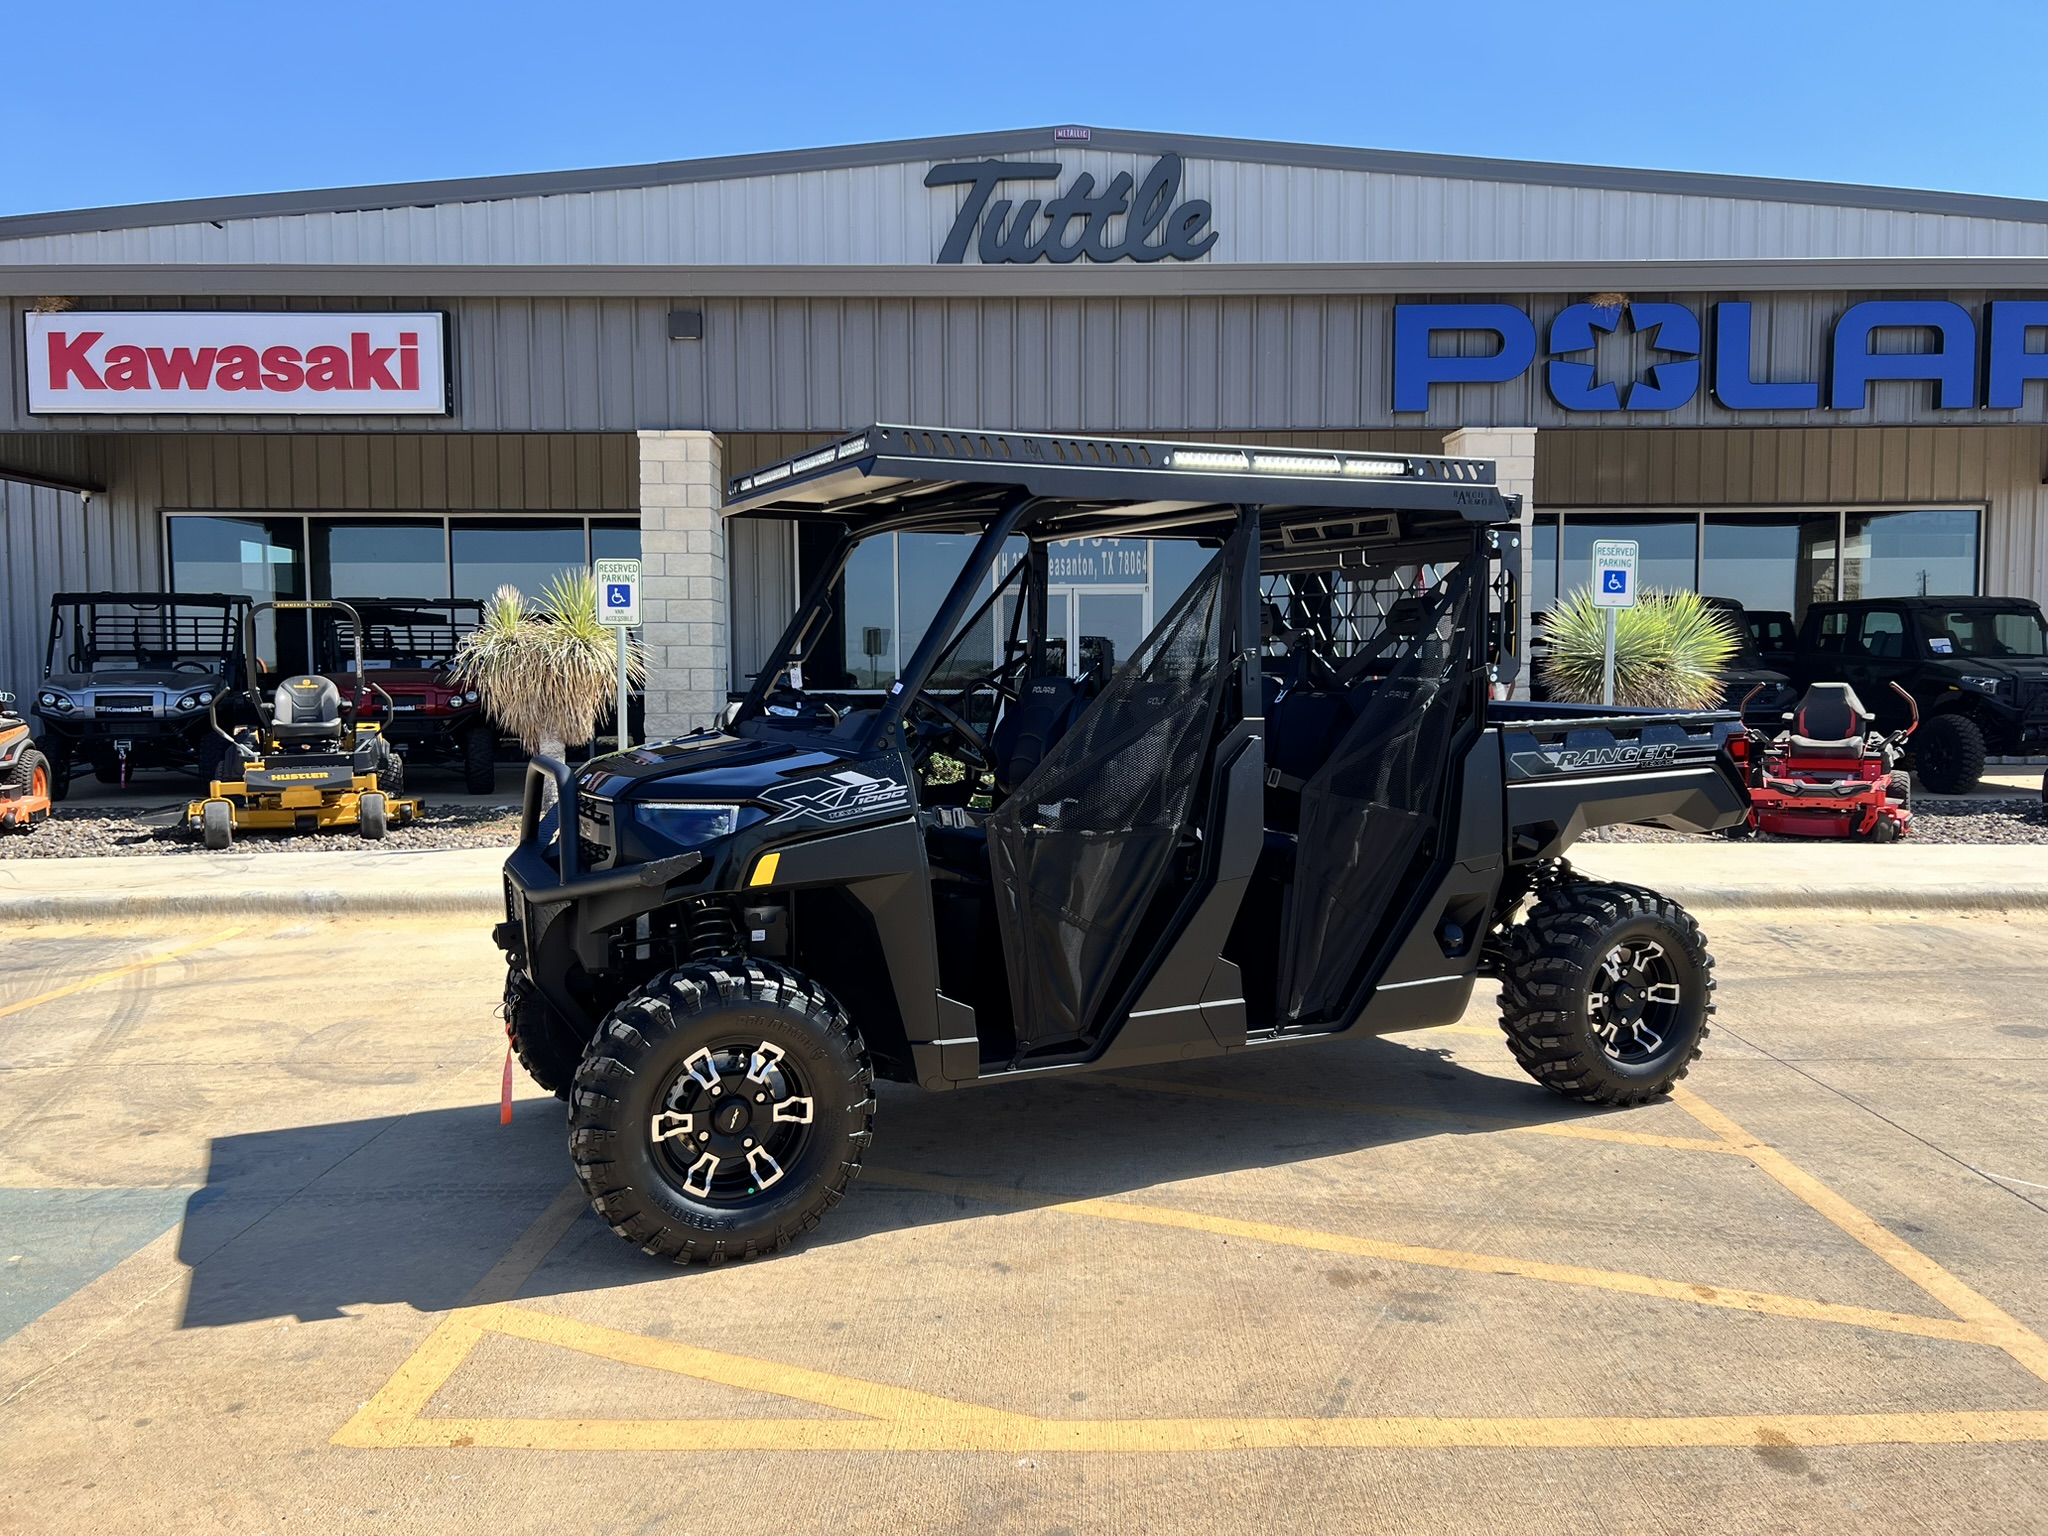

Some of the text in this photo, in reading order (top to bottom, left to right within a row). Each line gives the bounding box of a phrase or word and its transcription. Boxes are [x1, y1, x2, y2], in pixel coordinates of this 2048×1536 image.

[1057, 129, 1088, 138] METALLIC
[924, 152, 1219, 264] Tuttle
[47, 331, 420, 392] Kawasaki
[1597, 547, 1635, 557] RESERVED
[1048, 553, 1098, 580] easanton,
[1101, 551, 1115, 576] TX
[1118, 550, 1147, 576] 78064
[1599, 558, 1632, 568] PARKING
[598, 564, 638, 573] RESERVED
[601, 574, 636, 583] PARKING
[1031, 685, 1057, 695] POLARIS
[382, 704, 416, 712] Kwasaki
[1554, 743, 1679, 768] RANGER
[270, 771, 329, 781] HUSTLER
[857, 789, 907, 805] 1000
